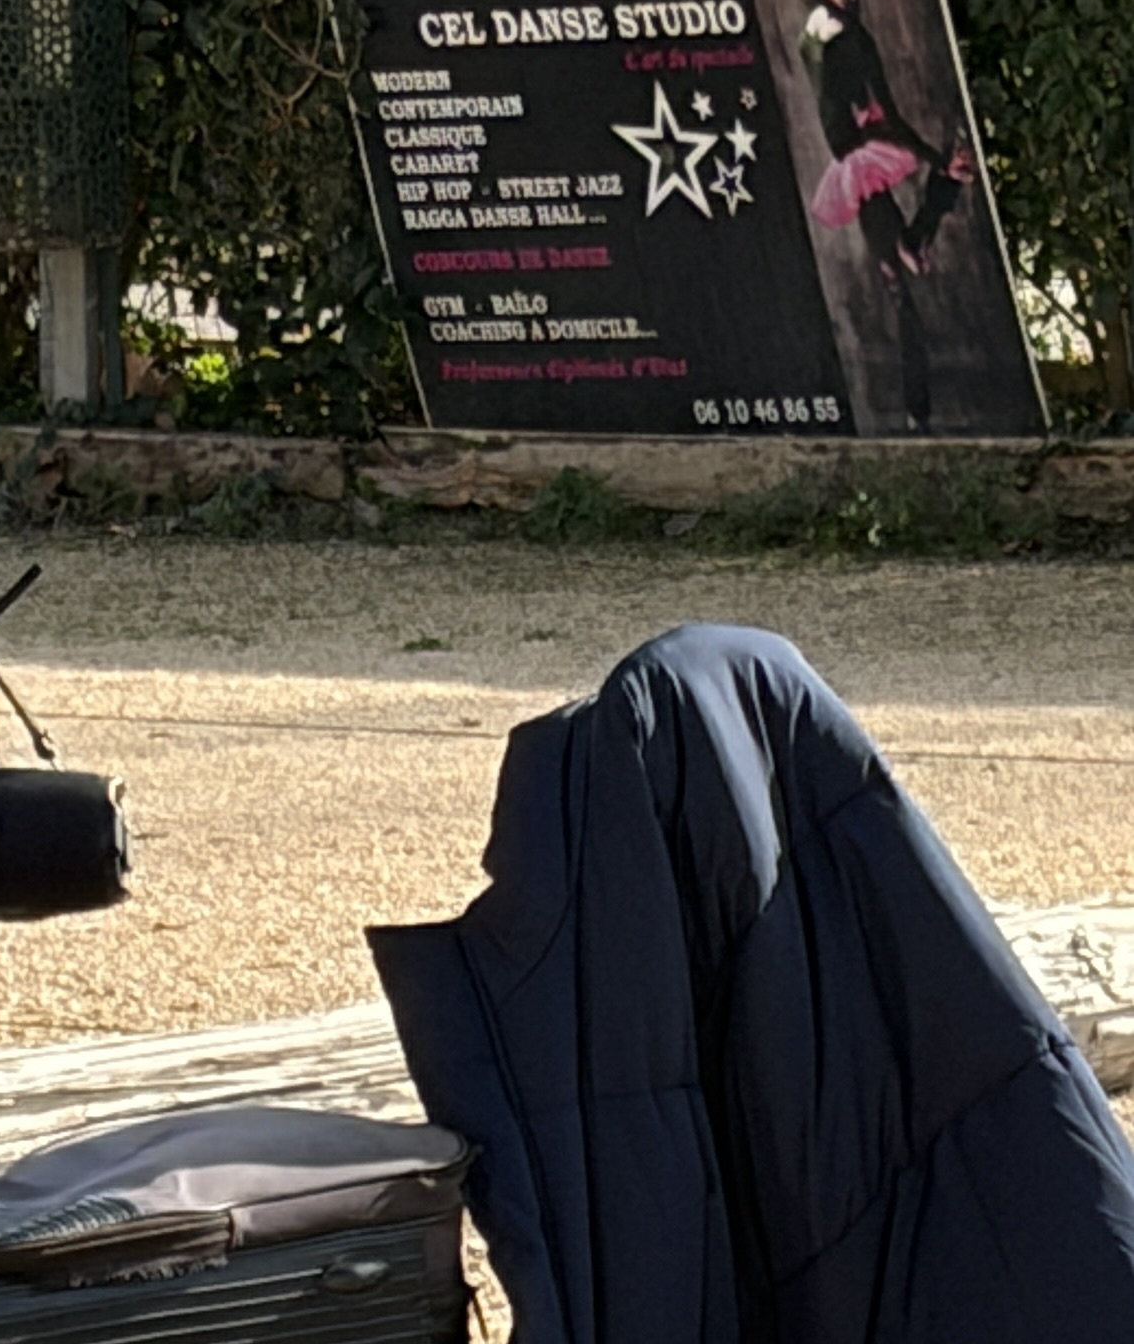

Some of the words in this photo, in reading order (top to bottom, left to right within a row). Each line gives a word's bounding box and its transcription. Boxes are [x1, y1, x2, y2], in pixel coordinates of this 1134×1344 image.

[419, 12, 487, 47] CEL
[491, 7, 609, 44] DANSE
[616, 0, 746, 39] STUDIO
[371, 69, 452, 93] MODERN
[379, 94, 525, 120] CONTEMPORAIN
[384, 124, 487, 149] CLASSIQUE
[390, 152, 480, 175] CABARET
[397, 181, 429, 202] HIP
[432, 180, 472, 202] HOP
[497, 176, 570, 199] STREET
[576, 174, 624, 196] JAZZ
[402, 208, 468, 230] RAGGA
[469, 205, 533, 229] DANSE
[414, 249, 514, 272] CONCOURS
[518, 247, 546, 269] DE
[423, 295, 467, 317] GYM
[430, 320, 526, 342] COACHING
[693, 398, 720, 425] 06
[724, 398, 750, 425] 10
[783, 396, 810, 423] 86
[813, 396, 840, 422] 55
